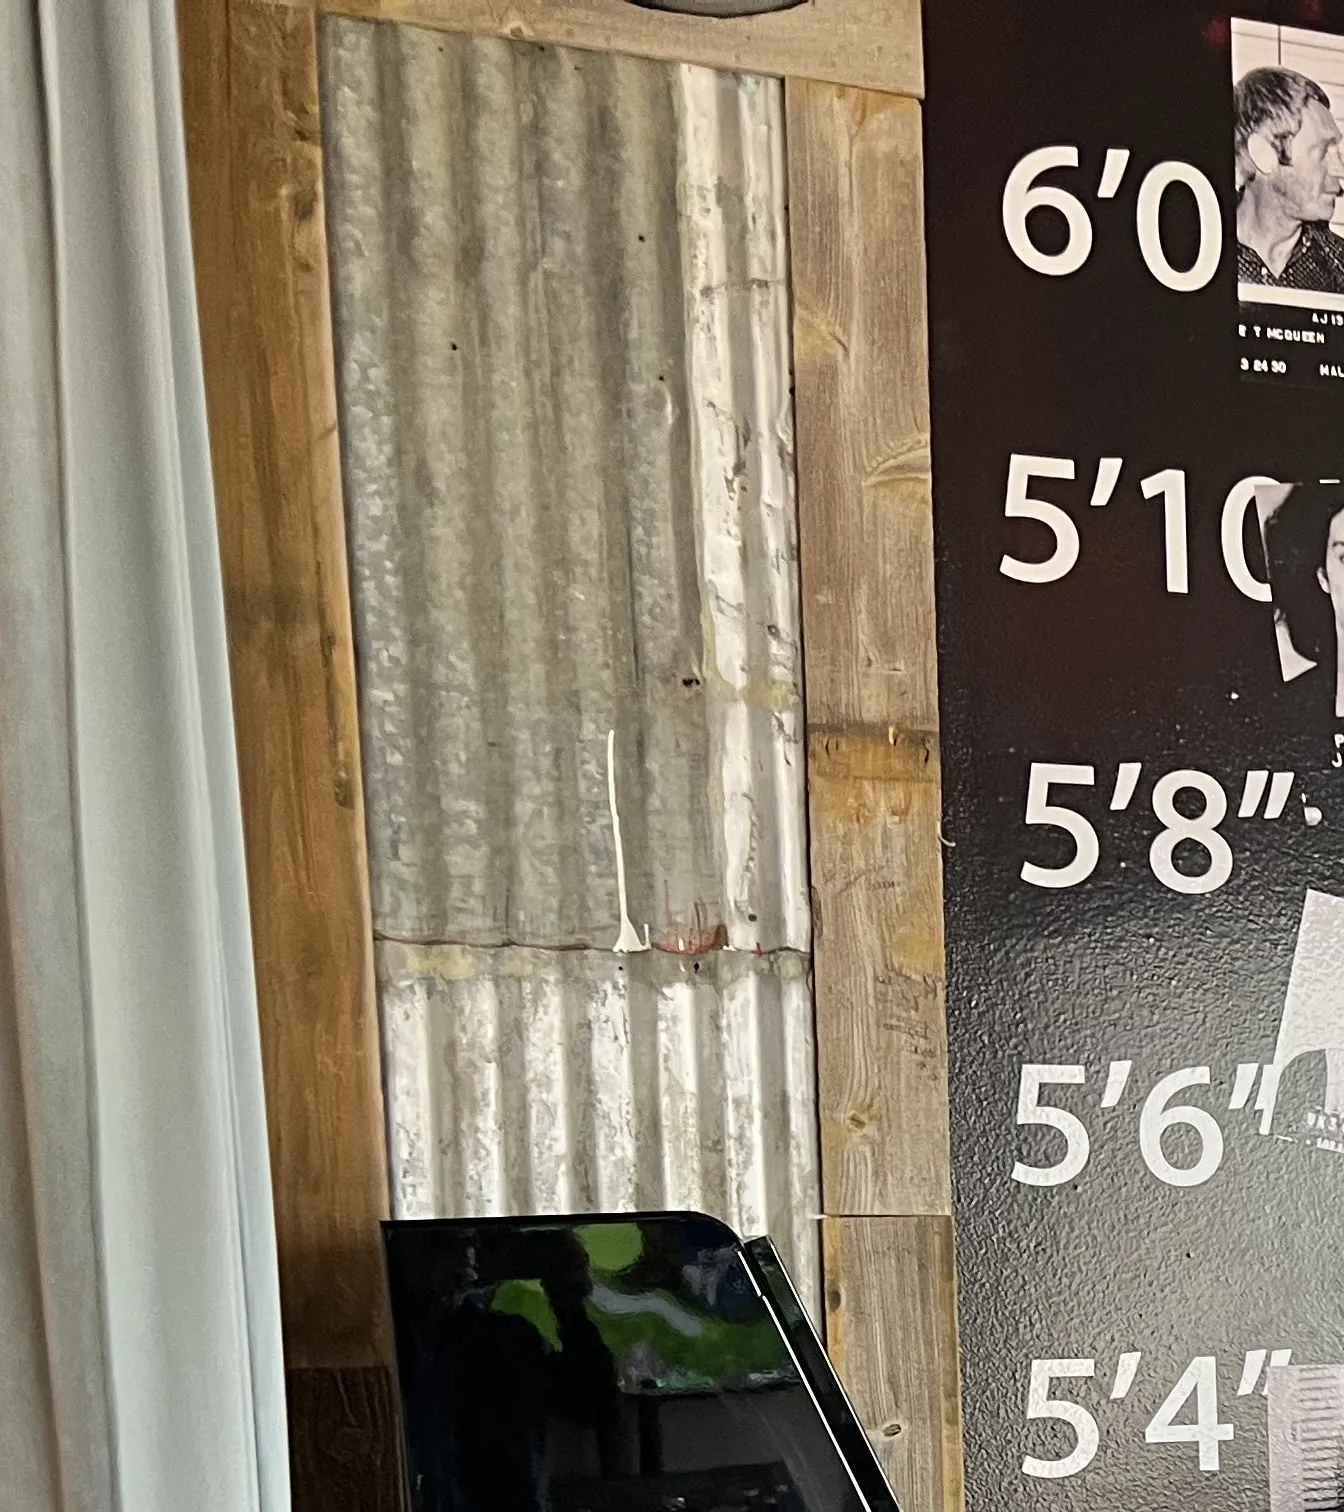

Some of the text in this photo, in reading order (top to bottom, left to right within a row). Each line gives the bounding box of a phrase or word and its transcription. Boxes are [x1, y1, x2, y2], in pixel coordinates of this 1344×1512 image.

[1253, 325, 1262, 338] T
[1266, 327, 1325, 344] MCQUEEN
[1020, 762, 1295, 893] 5'8"
[1010, 1060, 1275, 1187] 5'6"
[1022, 1349, 1292, 1478] 5'4"
